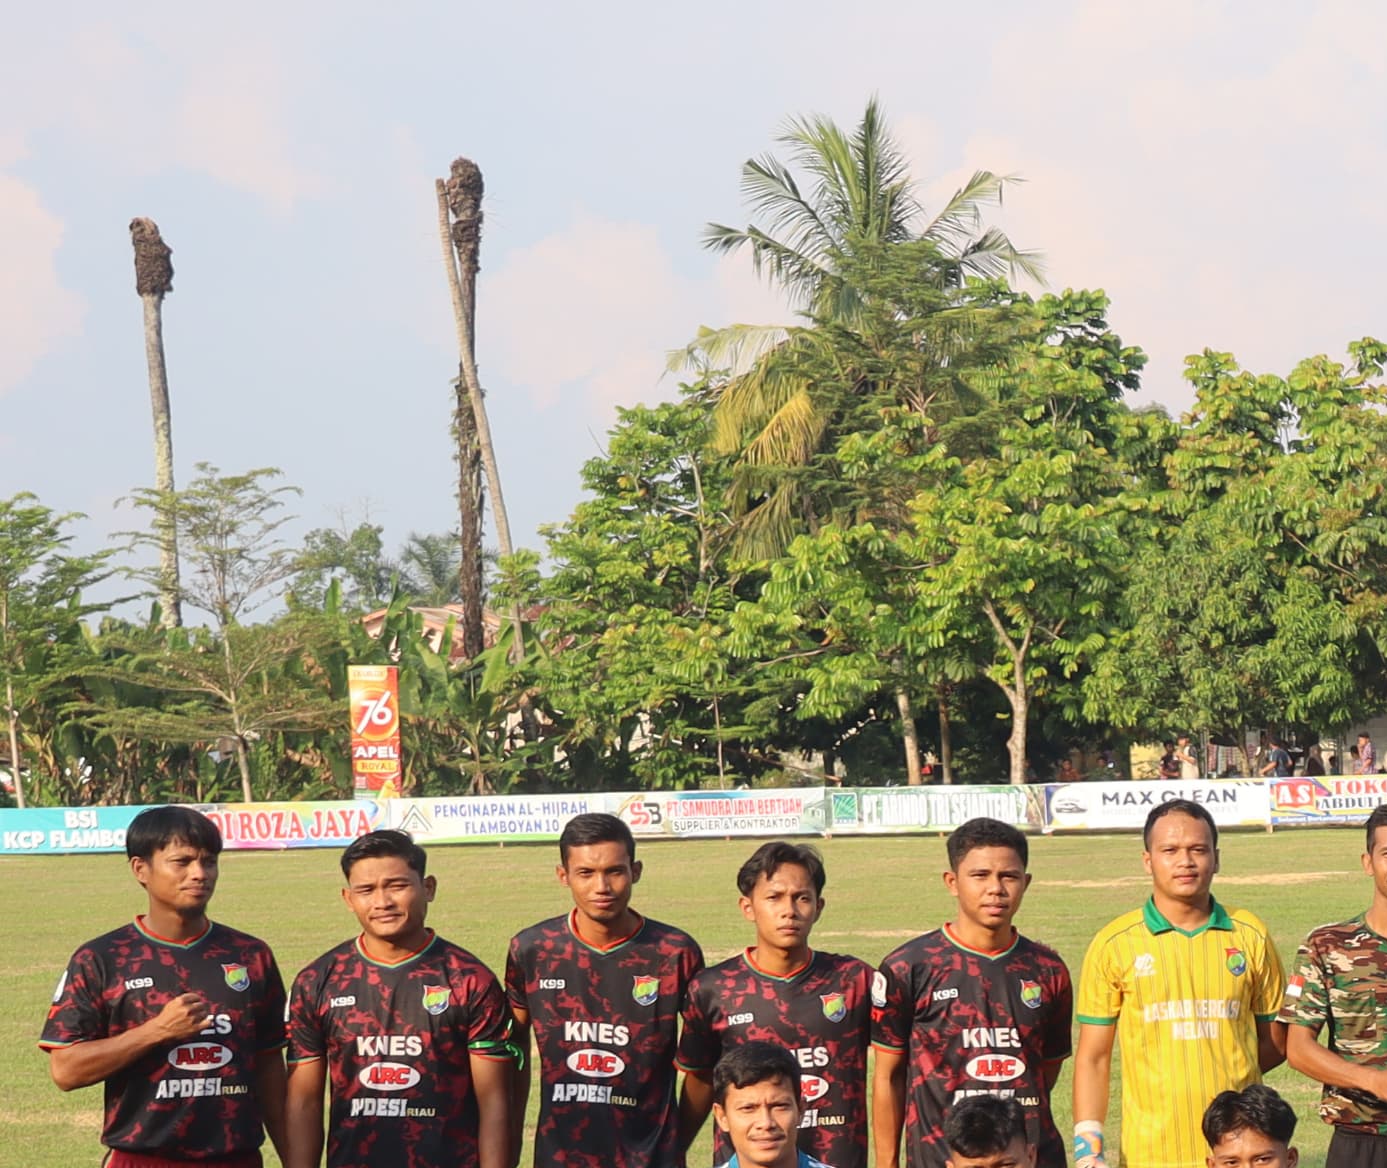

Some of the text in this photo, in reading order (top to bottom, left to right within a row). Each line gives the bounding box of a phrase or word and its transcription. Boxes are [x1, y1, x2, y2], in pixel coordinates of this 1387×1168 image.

[355, 690, 393, 734] 76
[354, 746, 398, 758] APEL
[360, 761, 394, 771] ROYAL
[1102, 789, 1151, 806] MAX
[434, 801, 588, 818] PENGINAPAN AL-HIJRAH
[682, 797, 804, 817] SAMUDRA JAYA BERTUAH
[930, 793, 949, 825] TRI
[64, 809, 98, 830] BSI
[238, 808, 373, 841] ROZA JAYA
[465, 820, 560, 835] FLAMBOYAN 10
[674, 818, 721, 831] SUPPLIER
[733, 816, 799, 830] KONTRAKTOR
[3, 829, 128, 850] KCP FLAMBO
[125, 977, 154, 991] K99
[539, 977, 566, 990] K99
[330, 996, 356, 1008] K99
[932, 988, 959, 1002] K99
[199, 1013, 233, 1035] ES
[728, 1012, 754, 1026] K99
[564, 1020, 630, 1047] KNES
[962, 1027, 1022, 1049] KNES
[356, 1035, 423, 1057] KNES
[155, 1077, 223, 1100] APDESI
[552, 1083, 637, 1107] APDESI RIAU
[406, 1108, 436, 1118] RIAU
